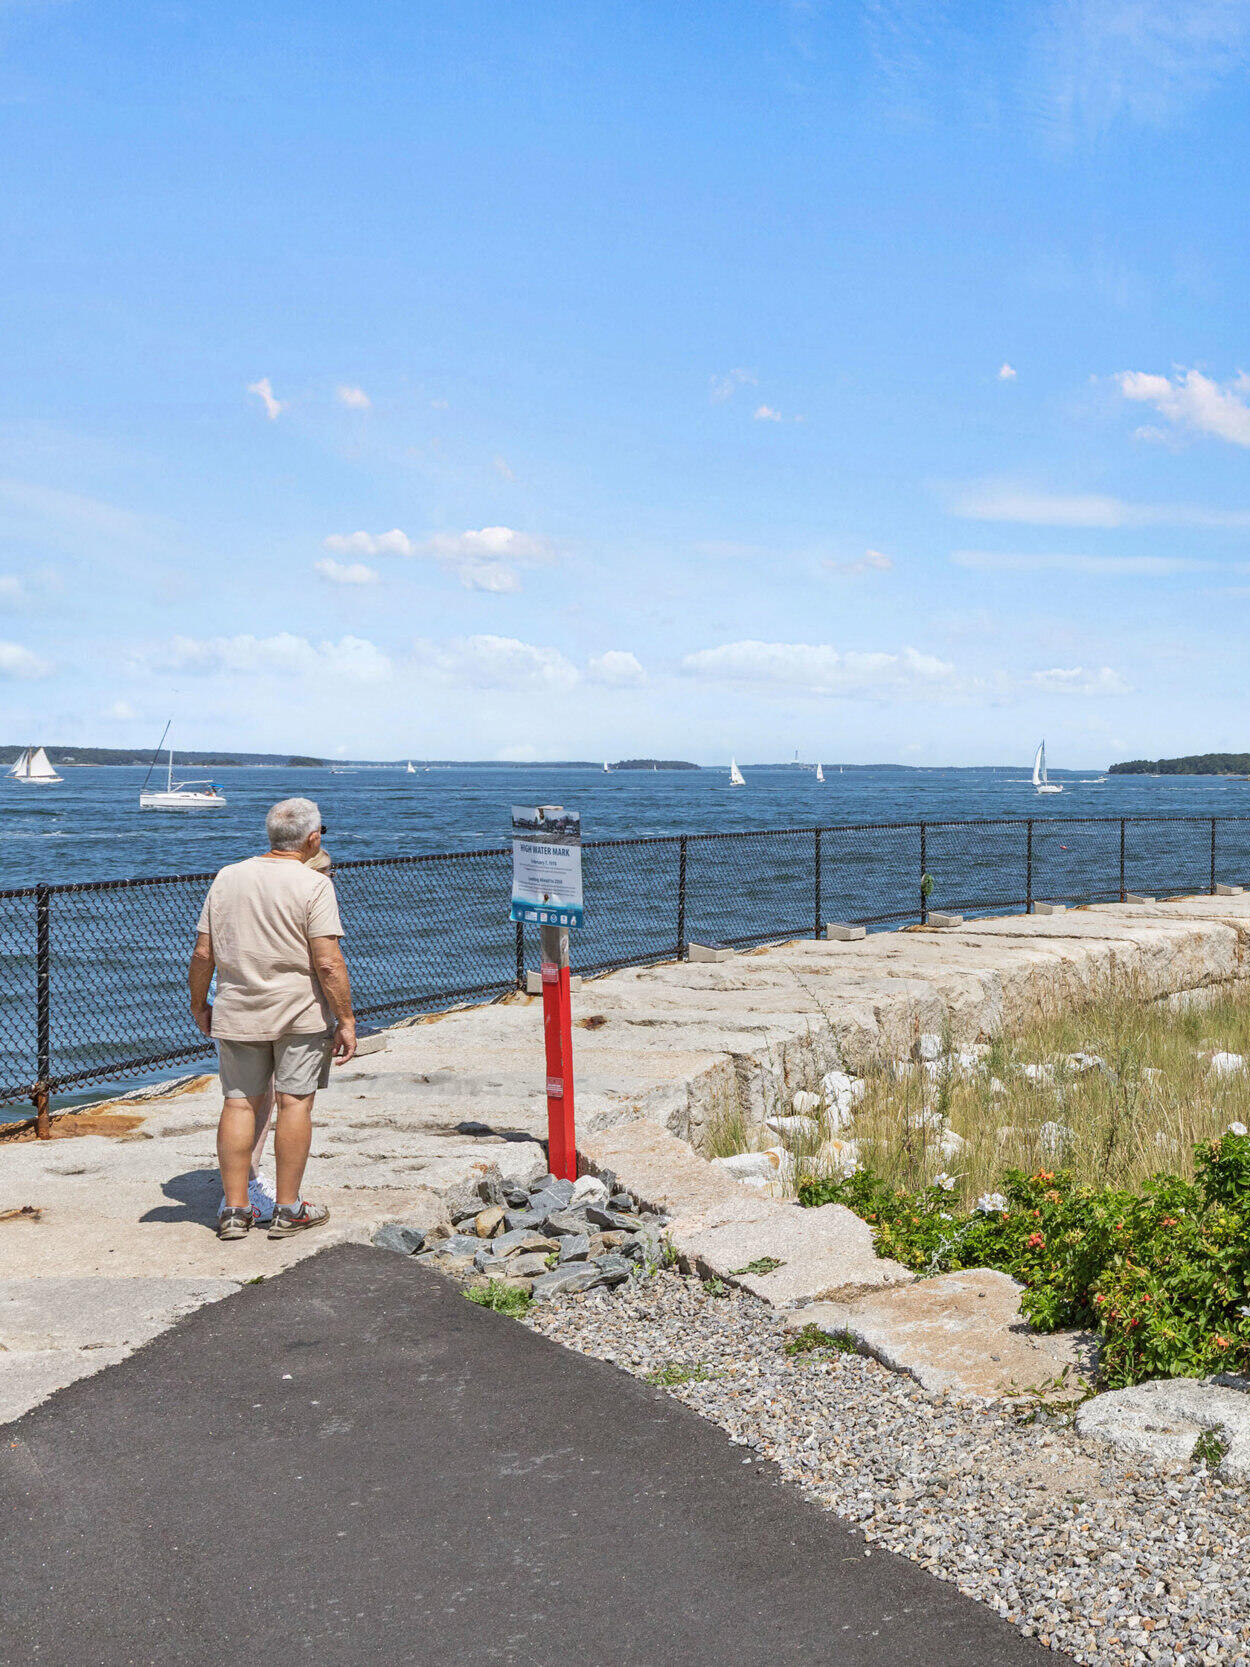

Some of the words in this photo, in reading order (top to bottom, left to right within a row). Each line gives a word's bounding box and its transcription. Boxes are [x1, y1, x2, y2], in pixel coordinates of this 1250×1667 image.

[520, 843, 532, 853] HIGH
[533, 846, 552, 855] WATER
[552, 848, 570, 857] MARK
